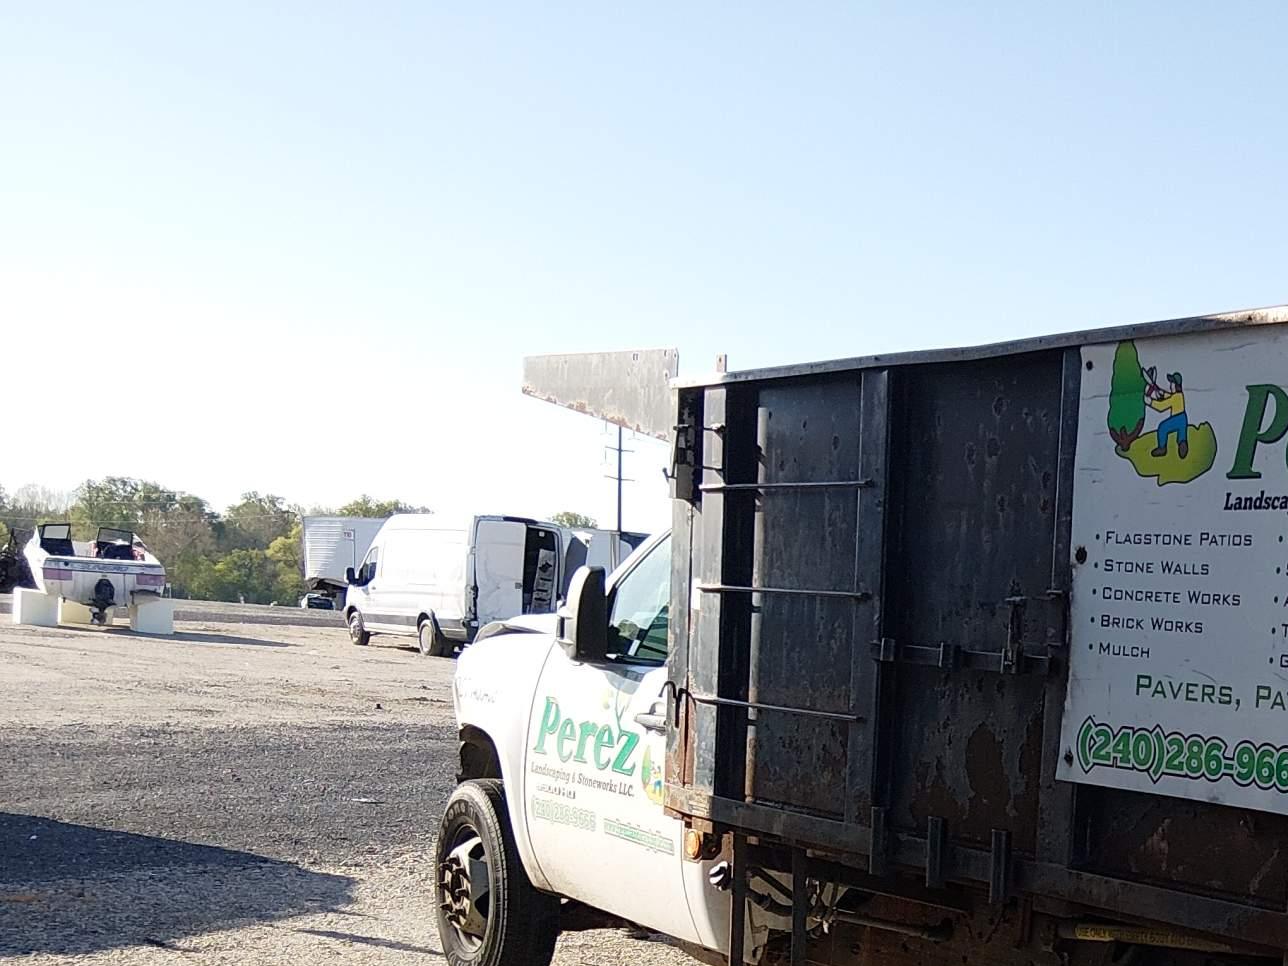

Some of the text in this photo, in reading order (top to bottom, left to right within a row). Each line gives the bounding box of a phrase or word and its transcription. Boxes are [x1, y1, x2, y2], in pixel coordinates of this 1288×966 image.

[1105, 531, 1253, 547] FLAGSTONE PATIOS
[1103, 559, 1210, 576] STONE WALLS
[1102, 587, 1241, 607] CONCRETE WORKS
[1100, 614, 1204, 634] BRICK WORKS
[1098, 642, 1150, 659] MULCH
[1136, 674, 1240, 711] PAVERS,
[533, 696, 640, 776] Perez
[577, 773, 617, 793] Stoneworks
